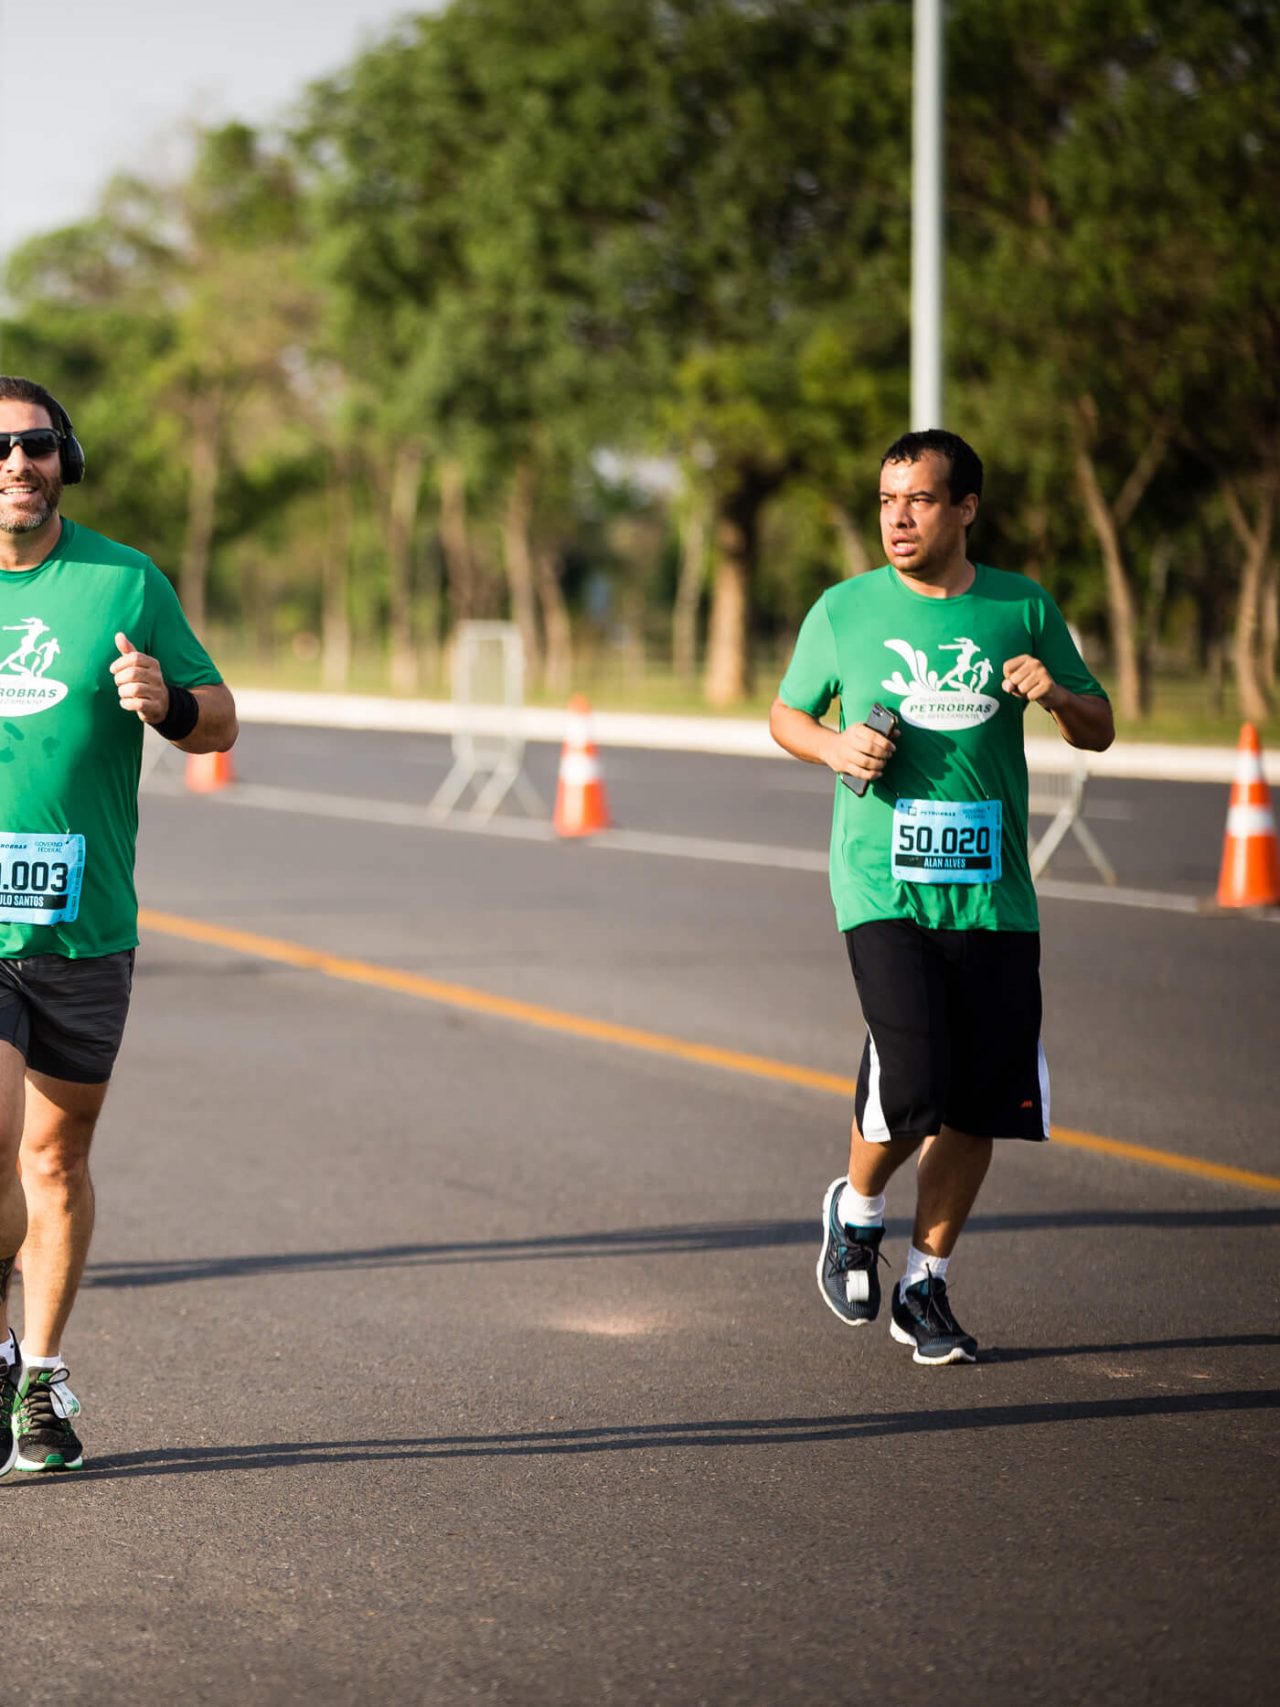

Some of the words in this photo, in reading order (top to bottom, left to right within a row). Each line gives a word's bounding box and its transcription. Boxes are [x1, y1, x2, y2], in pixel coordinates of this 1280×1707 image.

[909, 703, 992, 713] PETROBRAS
[899, 825, 990, 854] 50.020
[923, 857, 943, 868] ALAN
[944, 858, 966, 869] ALVES
[13, 894, 44, 908] SANTOS
